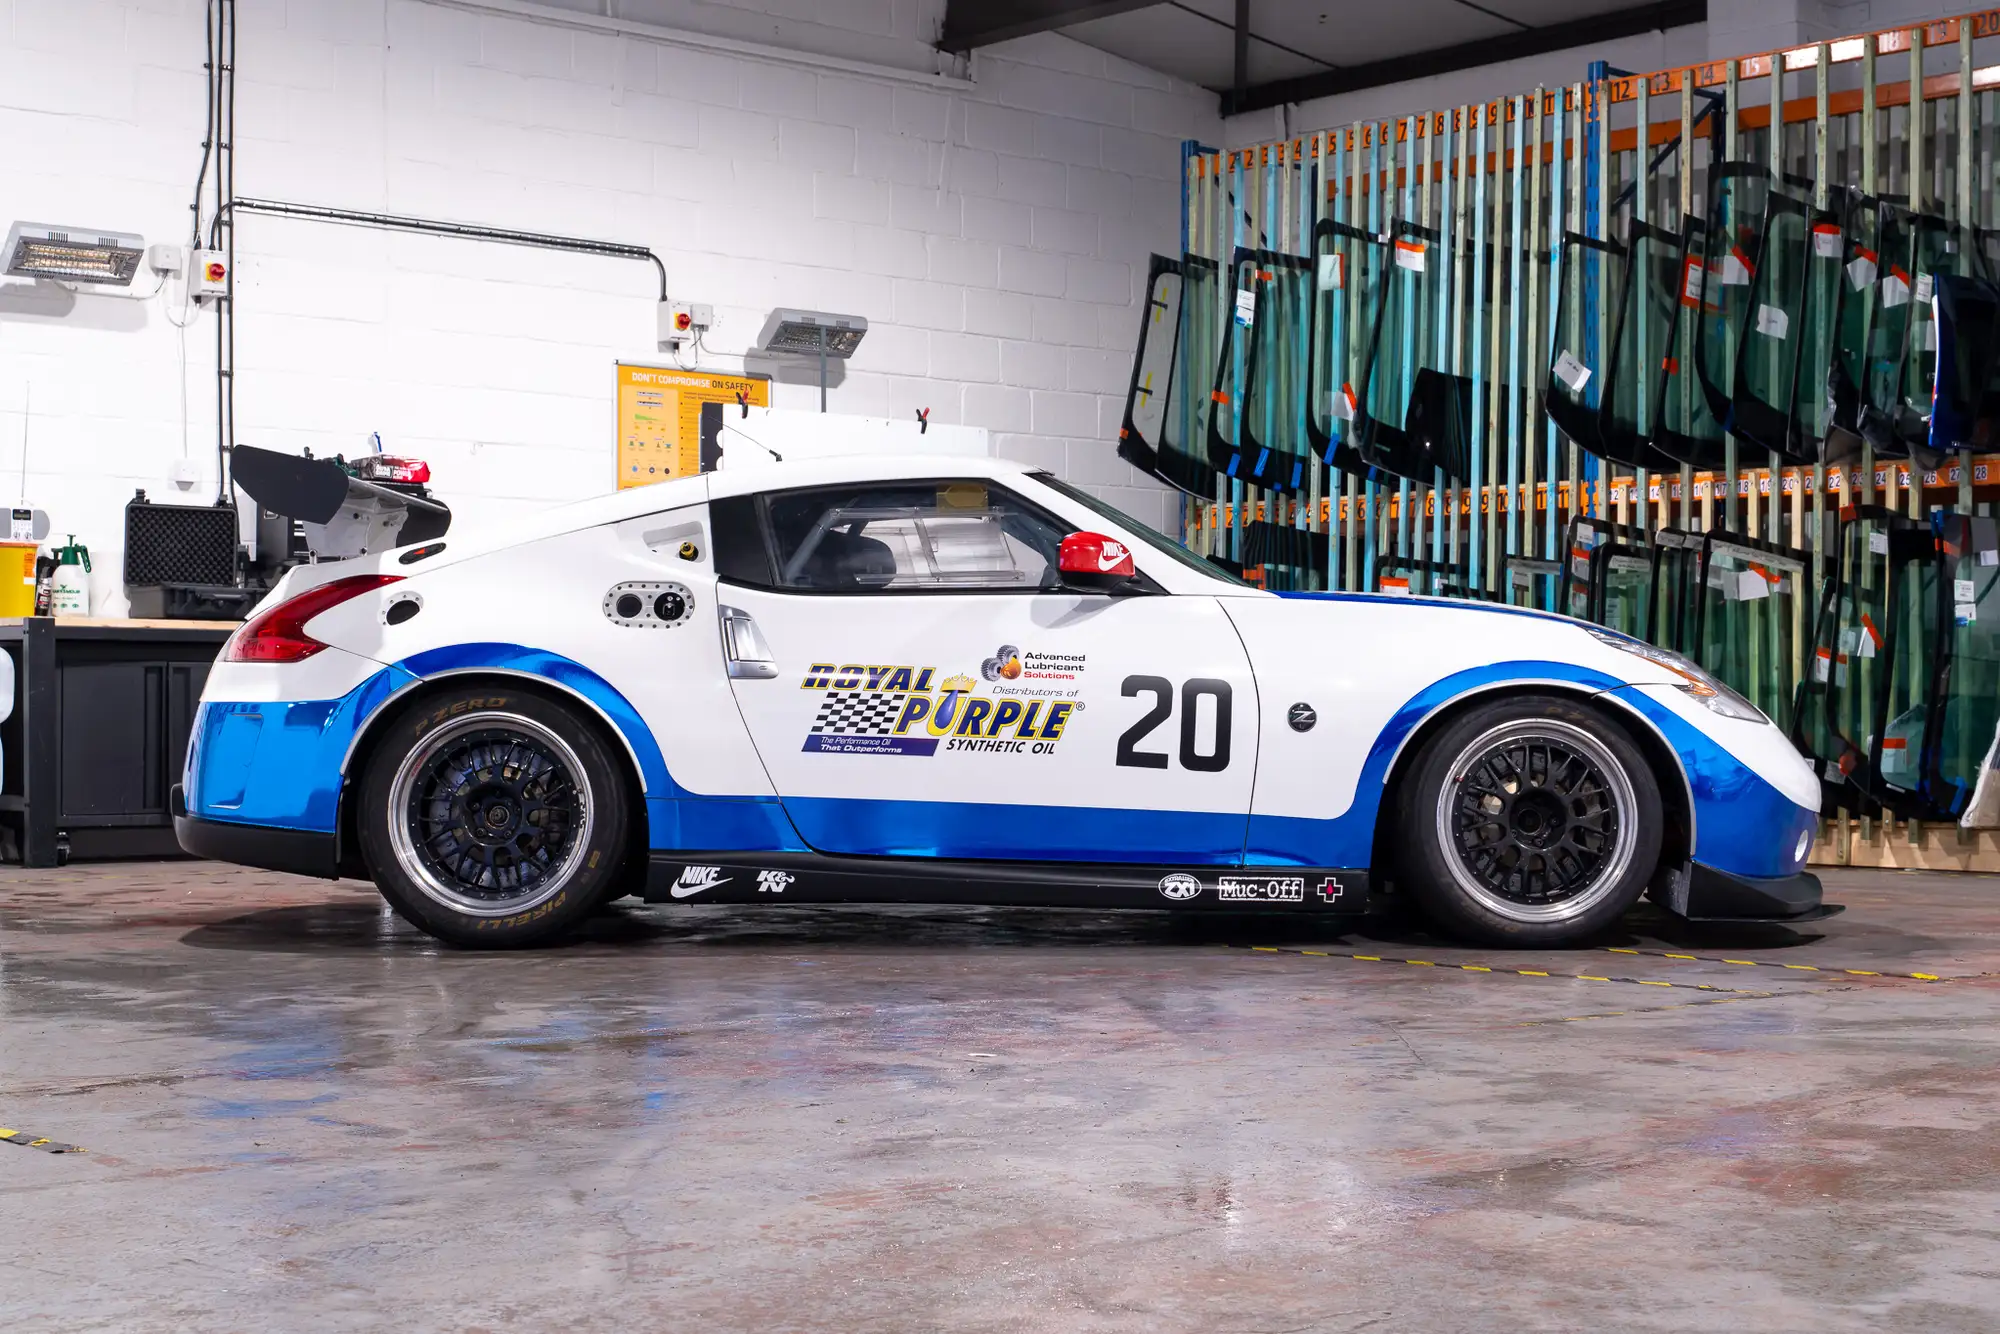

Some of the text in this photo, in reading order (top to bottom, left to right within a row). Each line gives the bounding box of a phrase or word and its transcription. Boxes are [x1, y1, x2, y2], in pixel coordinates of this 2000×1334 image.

[1613, 80, 1630, 100] 12
[1653, 72, 1670, 92] 13
[1700, 63, 1714, 86] 14
[1743, 57, 1760, 77] 15
[1977, 12, 2000, 34] 20
[1247, 149, 1254, 166] 2
[1400, 121, 1408, 141] 7
[1437, 115, 1444, 134] 8
[632, 372, 754, 391] DON'T COMPROMISE ON SAFETY
[1925, 471, 1936, 484] 26
[1975, 467, 1987, 480] 28
[1322, 504, 1329, 522] 5
[1341, 503, 1347, 520] 5
[1358, 502, 1365, 519] 6
[1428, 497, 1435, 515] 8
[1102, 541, 1124, 556] NIKE
[1024, 652, 1086, 661] Advanced
[1024, 662, 1085, 672] Lubricant
[1024, 671, 1075, 680] Solutions
[801, 663, 936, 693] ROYAL
[992, 685, 1080, 698] Distributors of
[893, 694, 1076, 741] PURPLE
[1116, 674, 1232, 772] 20
[821, 736, 834, 745] The
[835, 738, 880, 746] Performance
[821, 744, 903, 754] That Outperforms
[946, 739, 1055, 755] SYNTHETIC OIL
[680, 866, 720, 884] NIKE
[756, 870, 795, 892] K&N
[1164, 881, 1195, 898] ZX1
[1221, 880, 1300, 898] Muc-Off
[477, 891, 566, 929] PIRELLI
